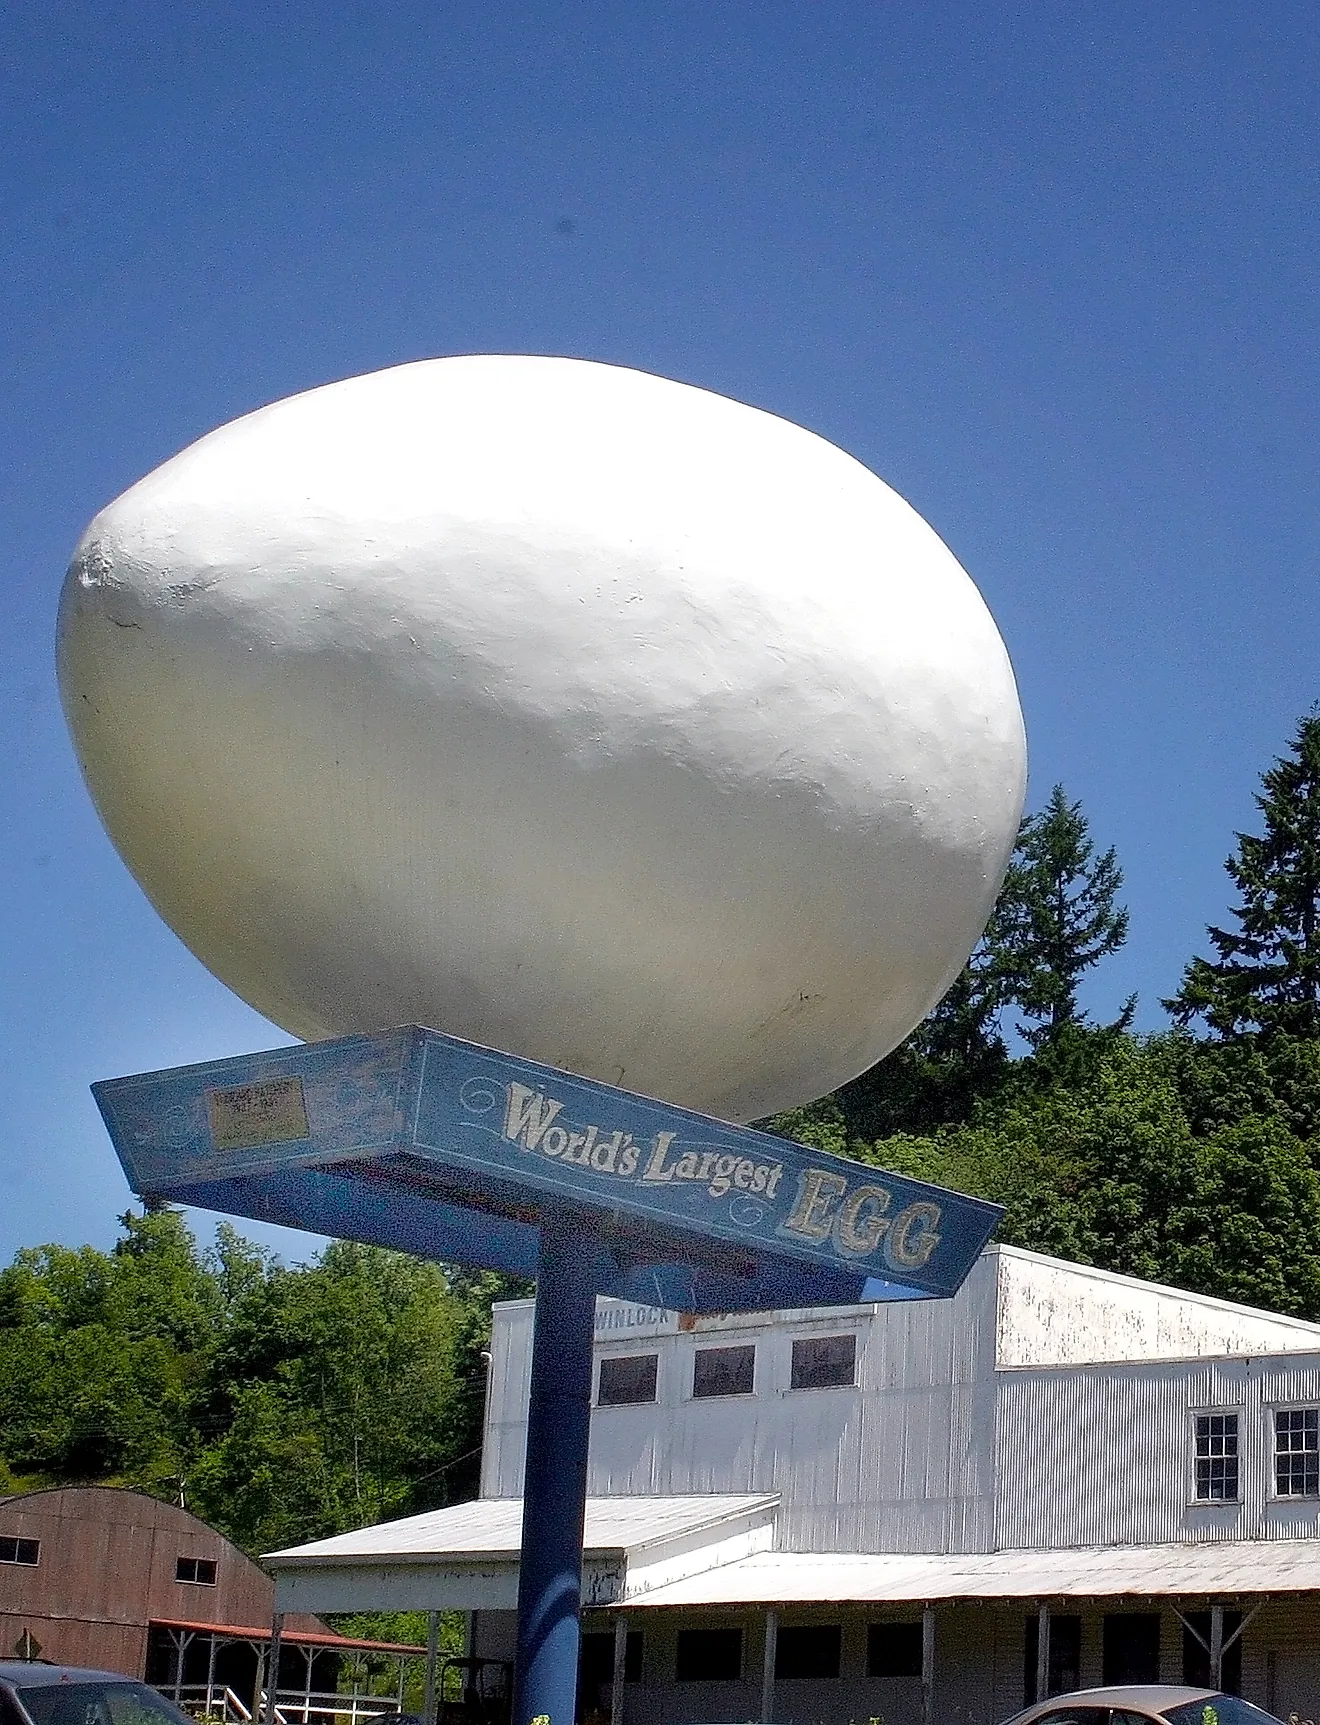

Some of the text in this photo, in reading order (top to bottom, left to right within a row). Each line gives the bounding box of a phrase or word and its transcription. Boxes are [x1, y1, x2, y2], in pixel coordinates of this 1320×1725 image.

[503, 1081, 943, 1271] World's Largest EGG
[595, 1307, 669, 1331] WINLOCK
